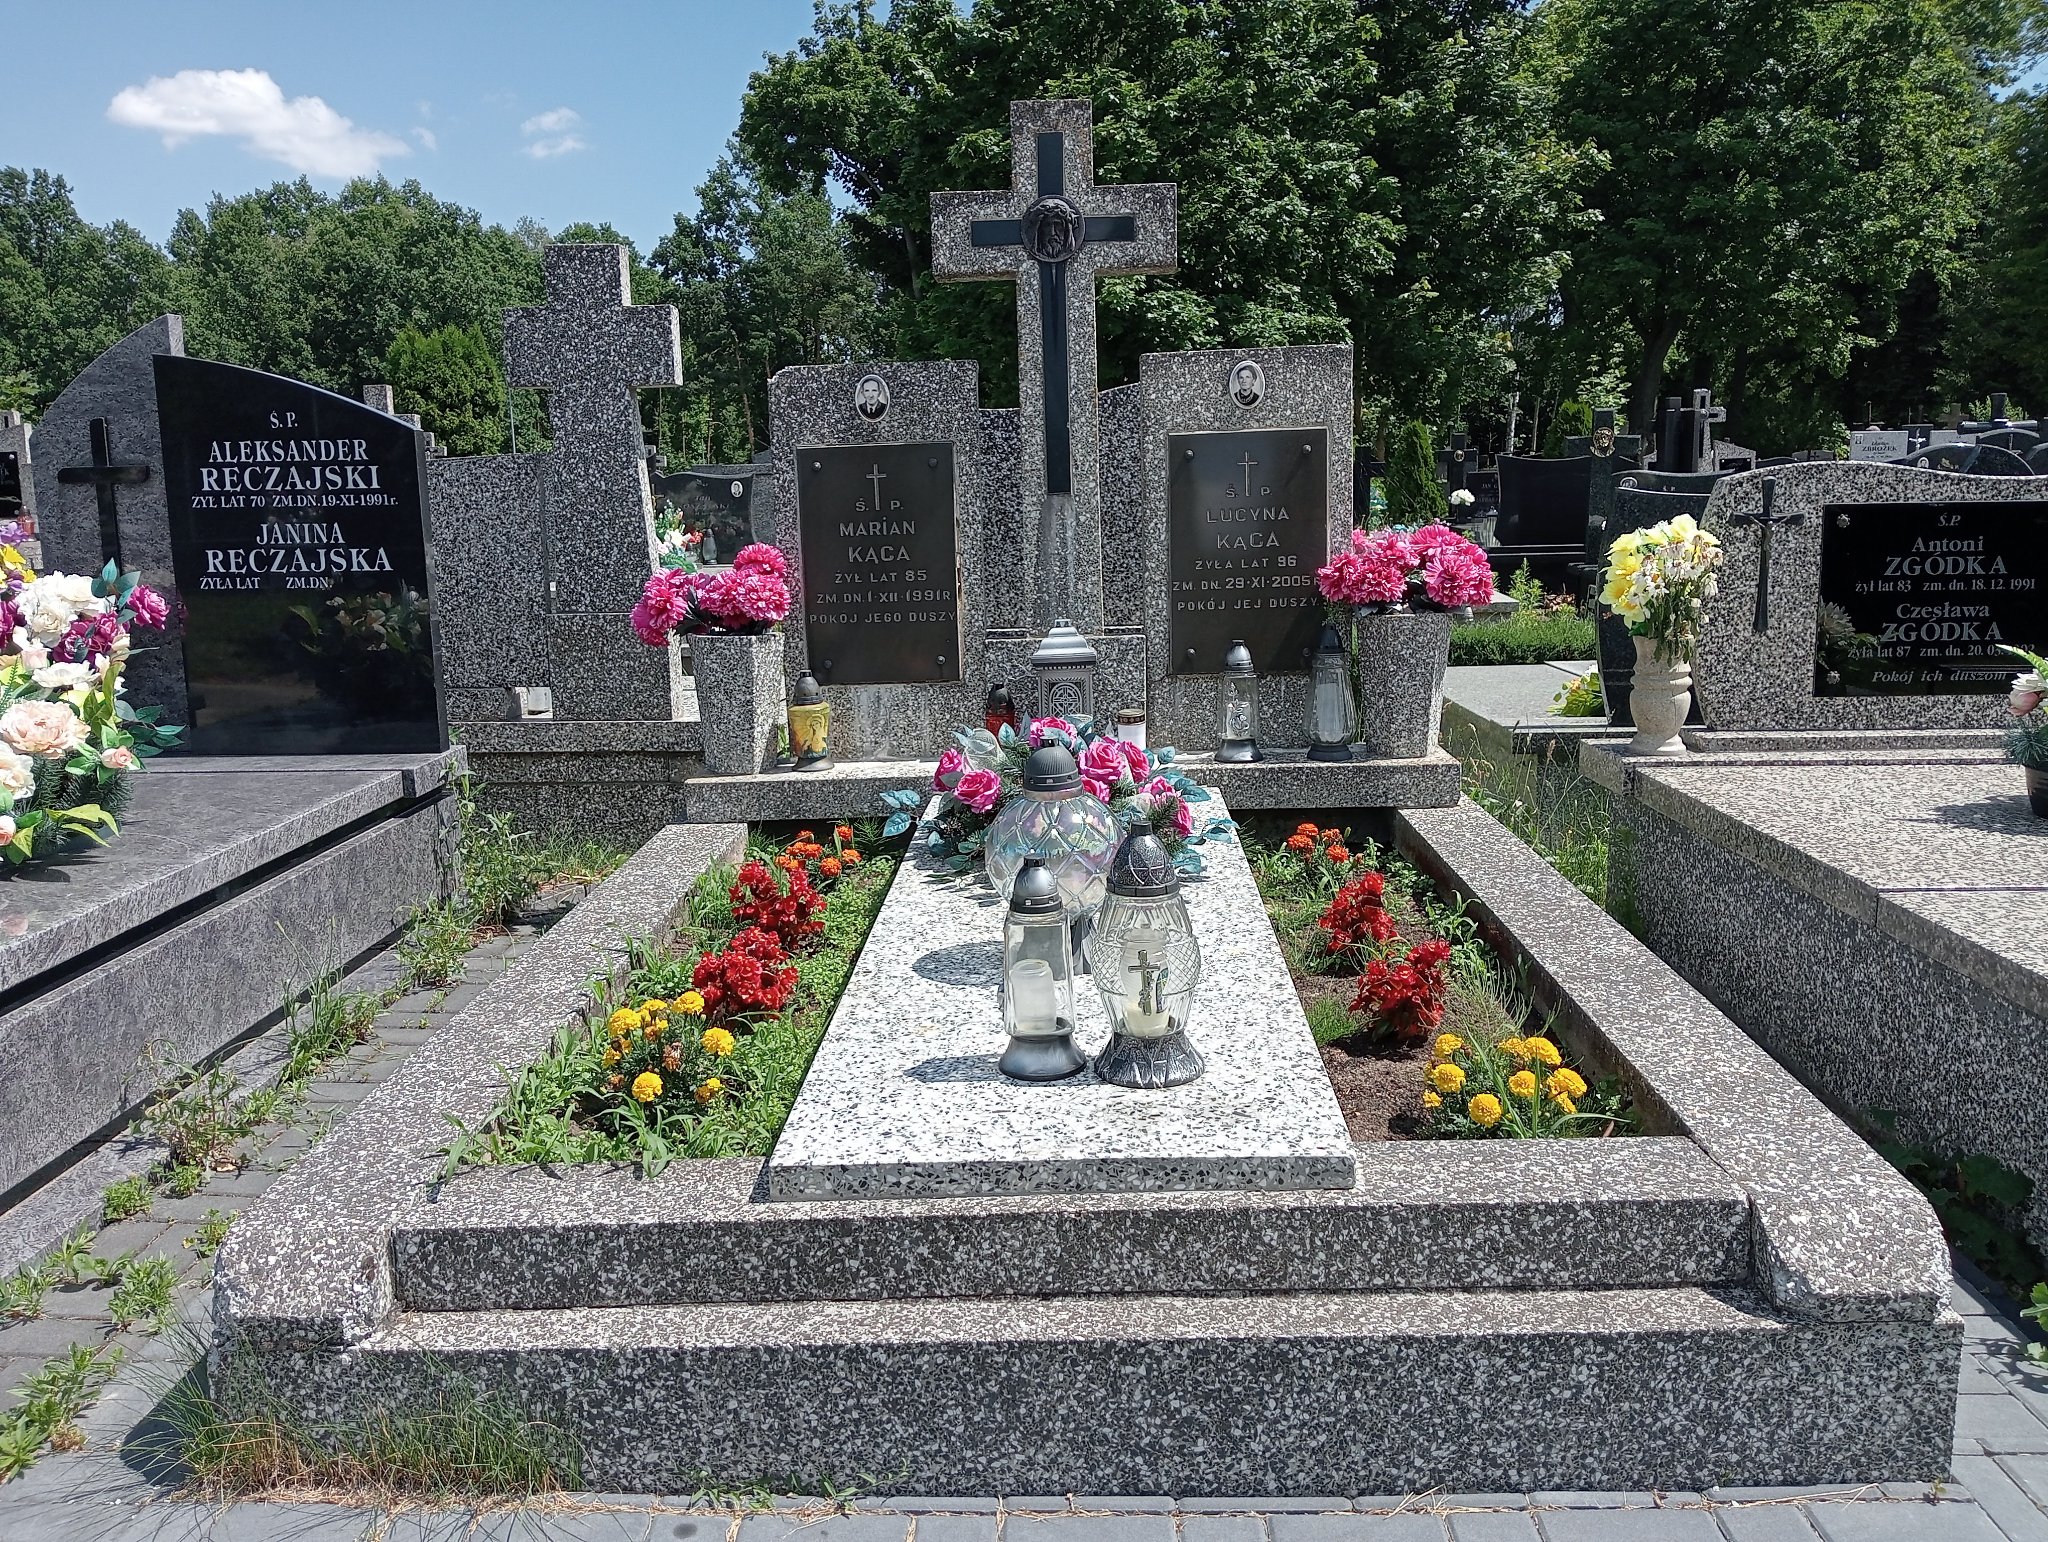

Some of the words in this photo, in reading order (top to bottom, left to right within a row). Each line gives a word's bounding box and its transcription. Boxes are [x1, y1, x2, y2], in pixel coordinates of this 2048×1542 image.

[208, 439, 369, 463] ALEKSANDER
[200, 464, 381, 493] RĘCZAJSKI
[191, 494, 218, 508] ŻYŁ
[220, 495, 246, 508] LAT
[250, 495, 266, 508] 70
[855, 498, 870, 512] Ś.
[890, 500, 904, 511] P.
[1206, 506, 1291, 523] LUCYNA
[256, 522, 346, 545] JANINA
[1217, 531, 1281, 551] KĄCA
[1911, 535, 1984, 552] Antoni
[206, 547, 394, 575] RĘCZAJSKA
[848, 545, 911, 565] KĄCA
[1241, 558, 1269, 569] LAT
[1277, 555, 1298, 567] 96
[1883, 552, 2008, 576] ZGÓDKA
[199, 576, 234, 590] ŻYŁA
[236, 576, 261, 590] LAT
[835, 570, 863, 584] ŻYŁ
[870, 572, 898, 583] LAT
[905, 569, 928, 582] 85
[1172, 581, 1196, 591] ZM.
[1855, 580, 1874, 595] żył
[1877, 579, 1894, 592] lat
[1897, 580, 1912, 593] 83
[1922, 581, 1946, 591] zm.
[1948, 579, 1968, 591] dn.
[1971, 579, 1987, 590] 18.
[1990, 578, 2006, 590] 12.
[2009, 578, 2036, 591] 1991
[816, 593, 840, 604] ZM.
[1177, 598, 1226, 611] POKÓJ
[1233, 600, 1262, 609] JEJ
[864, 612, 902, 623] JEGO
[908, 611, 956, 622] DUSZY
[1896, 601, 1990, 619] Czesława
[1879, 618, 2003, 642] ZGÓDKA
[1848, 645, 1874, 660] żyła
[1877, 644, 1893, 657] lat
[1896, 646, 1911, 657] 87
[1919, 648, 1942, 657] zm.
[1945, 645, 1964, 657] dn.
[1967, 645, 1984, 656] 20.
[1872, 670, 1914, 685] Pokój
[1920, 670, 1943, 682] ich
[1950, 669, 2007, 682] duszom
